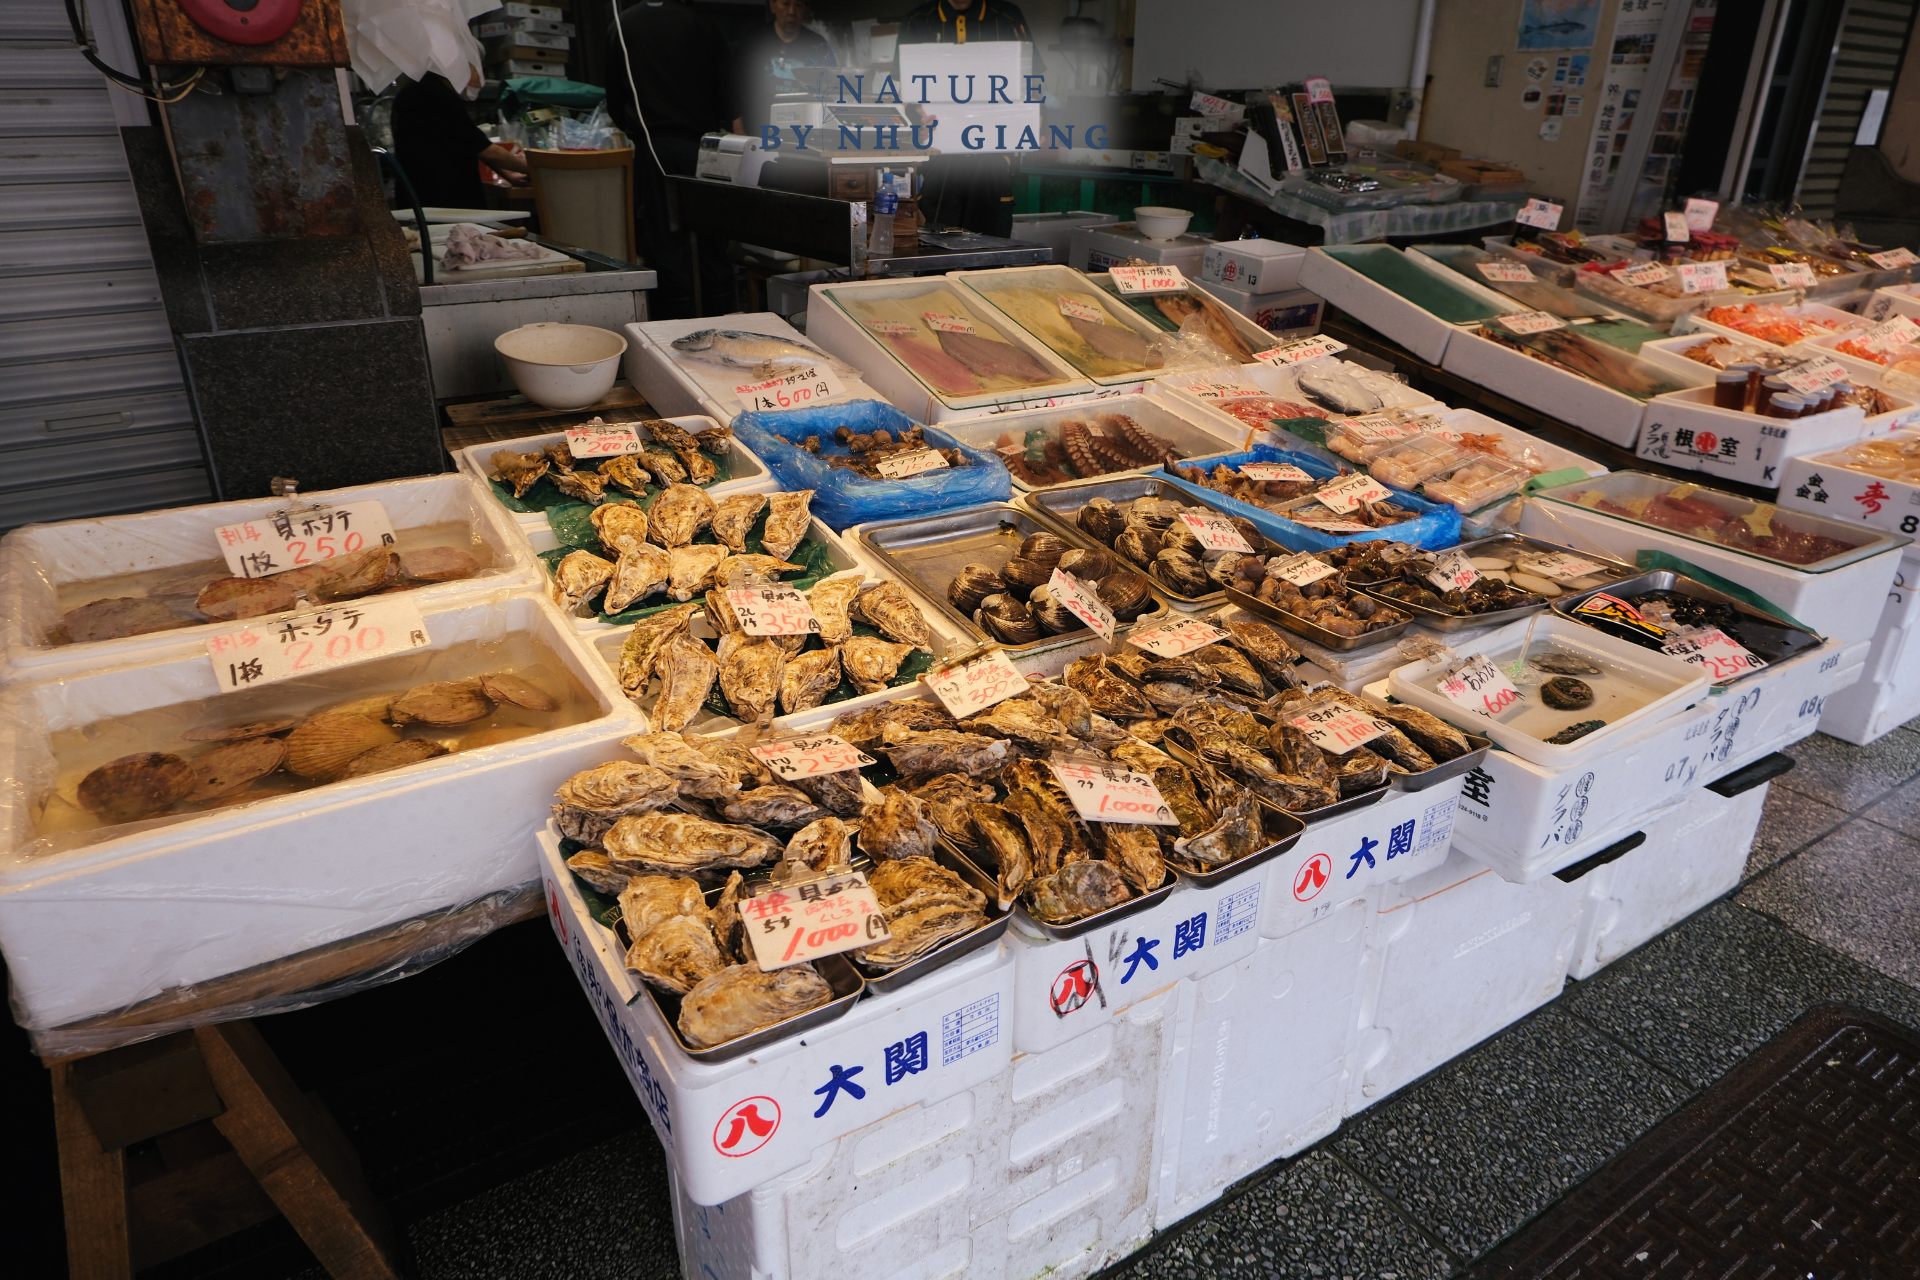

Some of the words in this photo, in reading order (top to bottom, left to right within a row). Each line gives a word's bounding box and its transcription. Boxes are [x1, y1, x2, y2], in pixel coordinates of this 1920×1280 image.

[1247, 274, 1258, 286] 13
[1288, 347, 1325, 361] 400
[776, 388, 812, 408] 600
[587, 441, 622, 453] 200
[1674, 428, 1695, 448] 根
[1718, 437, 1741, 458] 室
[904, 461, 935, 474] 150
[1269, 471, 1302, 479] 900
[1763, 465, 1776, 481] K
[1347, 490, 1379, 506] 600
[220, 522, 262, 546] 刺身
[1900, 515, 1919, 534] 8
[1212, 533, 1240, 548] 550
[239, 551, 278, 578] 1枚
[286, 532, 364, 564] 250
[1299, 565, 1322, 578] 750
[1453, 569, 1475, 589] 750
[279, 609, 365, 643] ホタテ
[760, 612, 808, 634] 350
[1066, 600, 1103, 629] 500
[210, 630, 261, 654] 刺身
[1167, 630, 1217, 651] 250
[229, 657, 264, 687] 1枚
[283, 627, 386, 671] 200
[1702, 654, 1748, 679] 250
[1461, 661, 1497, 691] あわび
[968, 680, 1008, 704] 300
[1483, 688, 1517, 714] 600
[1334, 723, 1376, 746] 1.100
[797, 754, 857, 773] 250
[1461, 766, 1496, 808] 室
[1099, 794, 1156, 813] 1.000
[1346, 819, 1416, 880] 大関
[781, 922, 860, 962] 1.000
[1121, 911, 1208, 986] 大関
[813, 1030, 929, 1119] 大関
